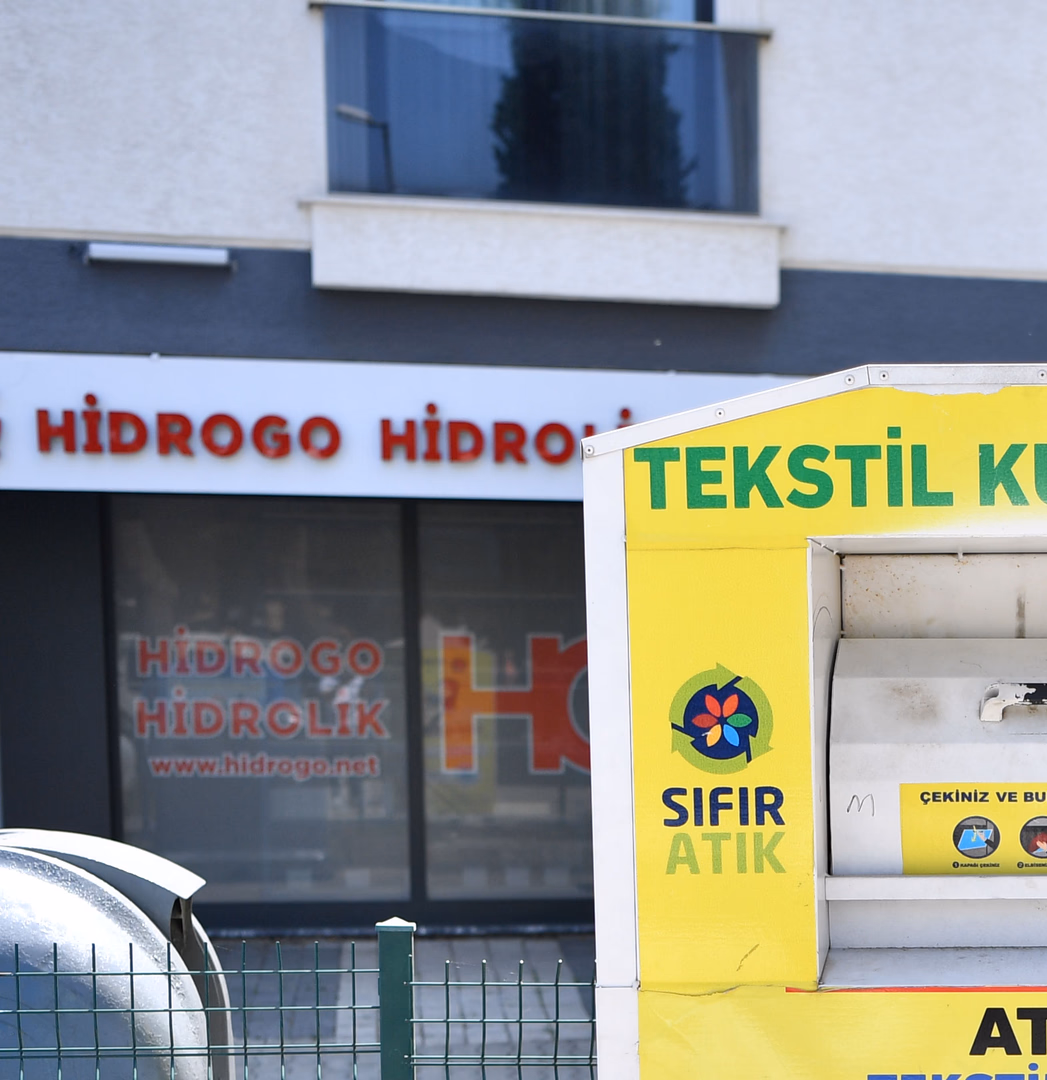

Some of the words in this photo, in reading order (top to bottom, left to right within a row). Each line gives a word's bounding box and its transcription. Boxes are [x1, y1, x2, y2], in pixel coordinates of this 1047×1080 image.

[36, 393, 341, 459] HİDROGO
[380, 402, 635, 465] HİDRO
[634, 426, 954, 509] TEKSTİL
[137, 625, 383, 677] HİDROGO
[150, 752, 379, 781] www.hidrogo.net
[662, 786, 786, 827] SIFIR
[920, 789, 989, 805] ÇEKİNİZ
[996, 791, 1018, 803] VE
[665, 832, 787, 875] ATIK
